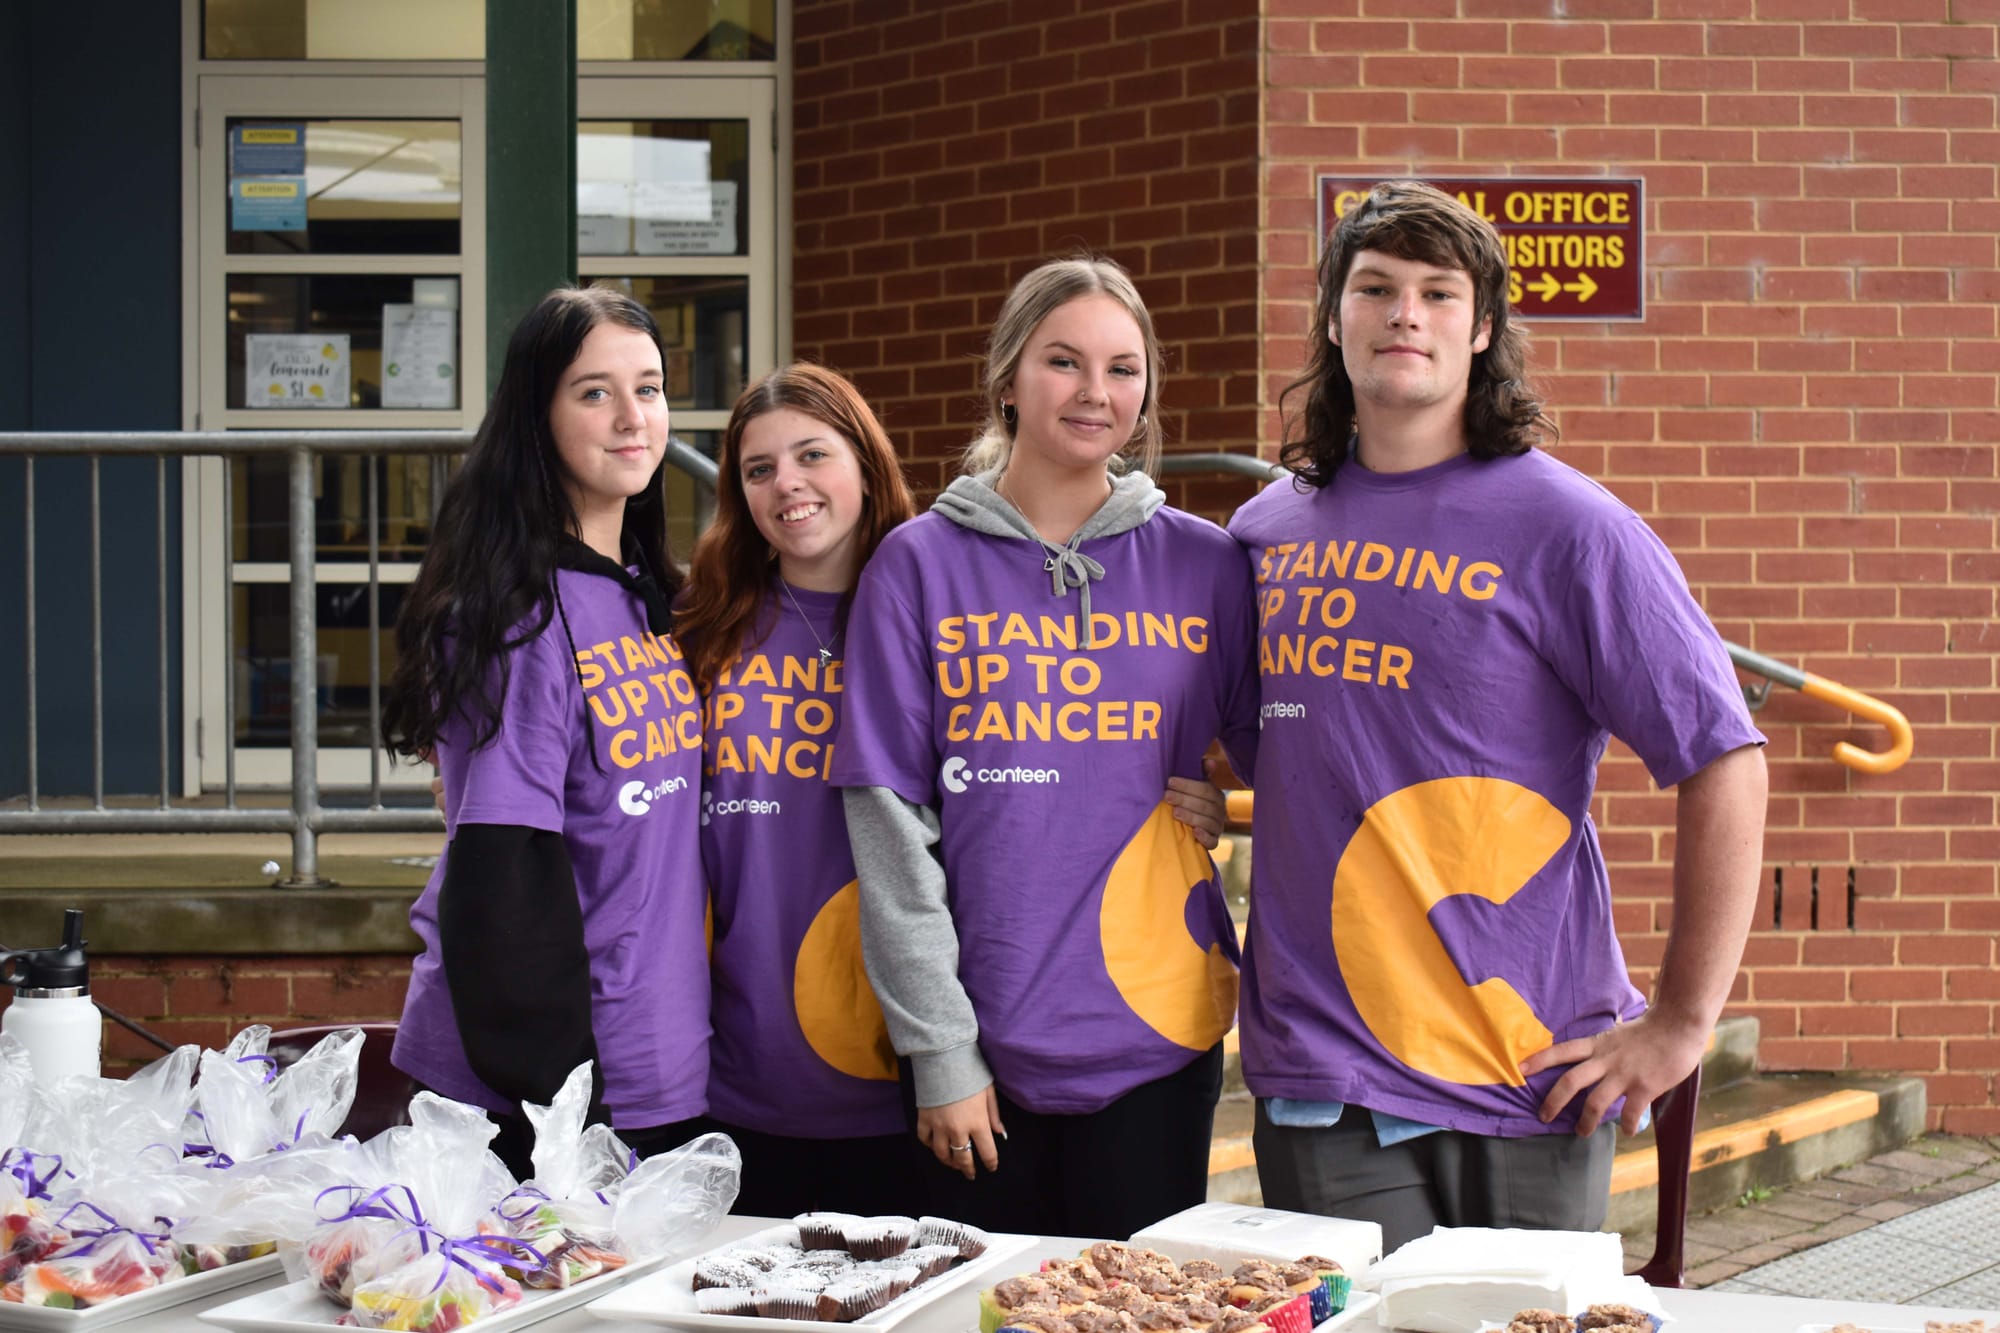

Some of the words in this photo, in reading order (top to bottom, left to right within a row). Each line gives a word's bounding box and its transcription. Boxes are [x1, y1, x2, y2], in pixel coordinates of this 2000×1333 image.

[1504, 191, 1630, 223] OFFICE
[1257, 540, 1503, 601] STANDING
[1297, 586, 1357, 629] TO
[936, 611, 1209, 654] STANDING
[587, 679, 649, 727] UP
[648, 668, 696, 709] TO
[937, 654, 1009, 698] UP
[1025, 654, 1101, 695] TO
[761, 693, 835, 735] TO
[946, 701, 1162, 742] CANCER
[609, 710, 703, 769] CANC
[977, 764, 1060, 784] canteen
